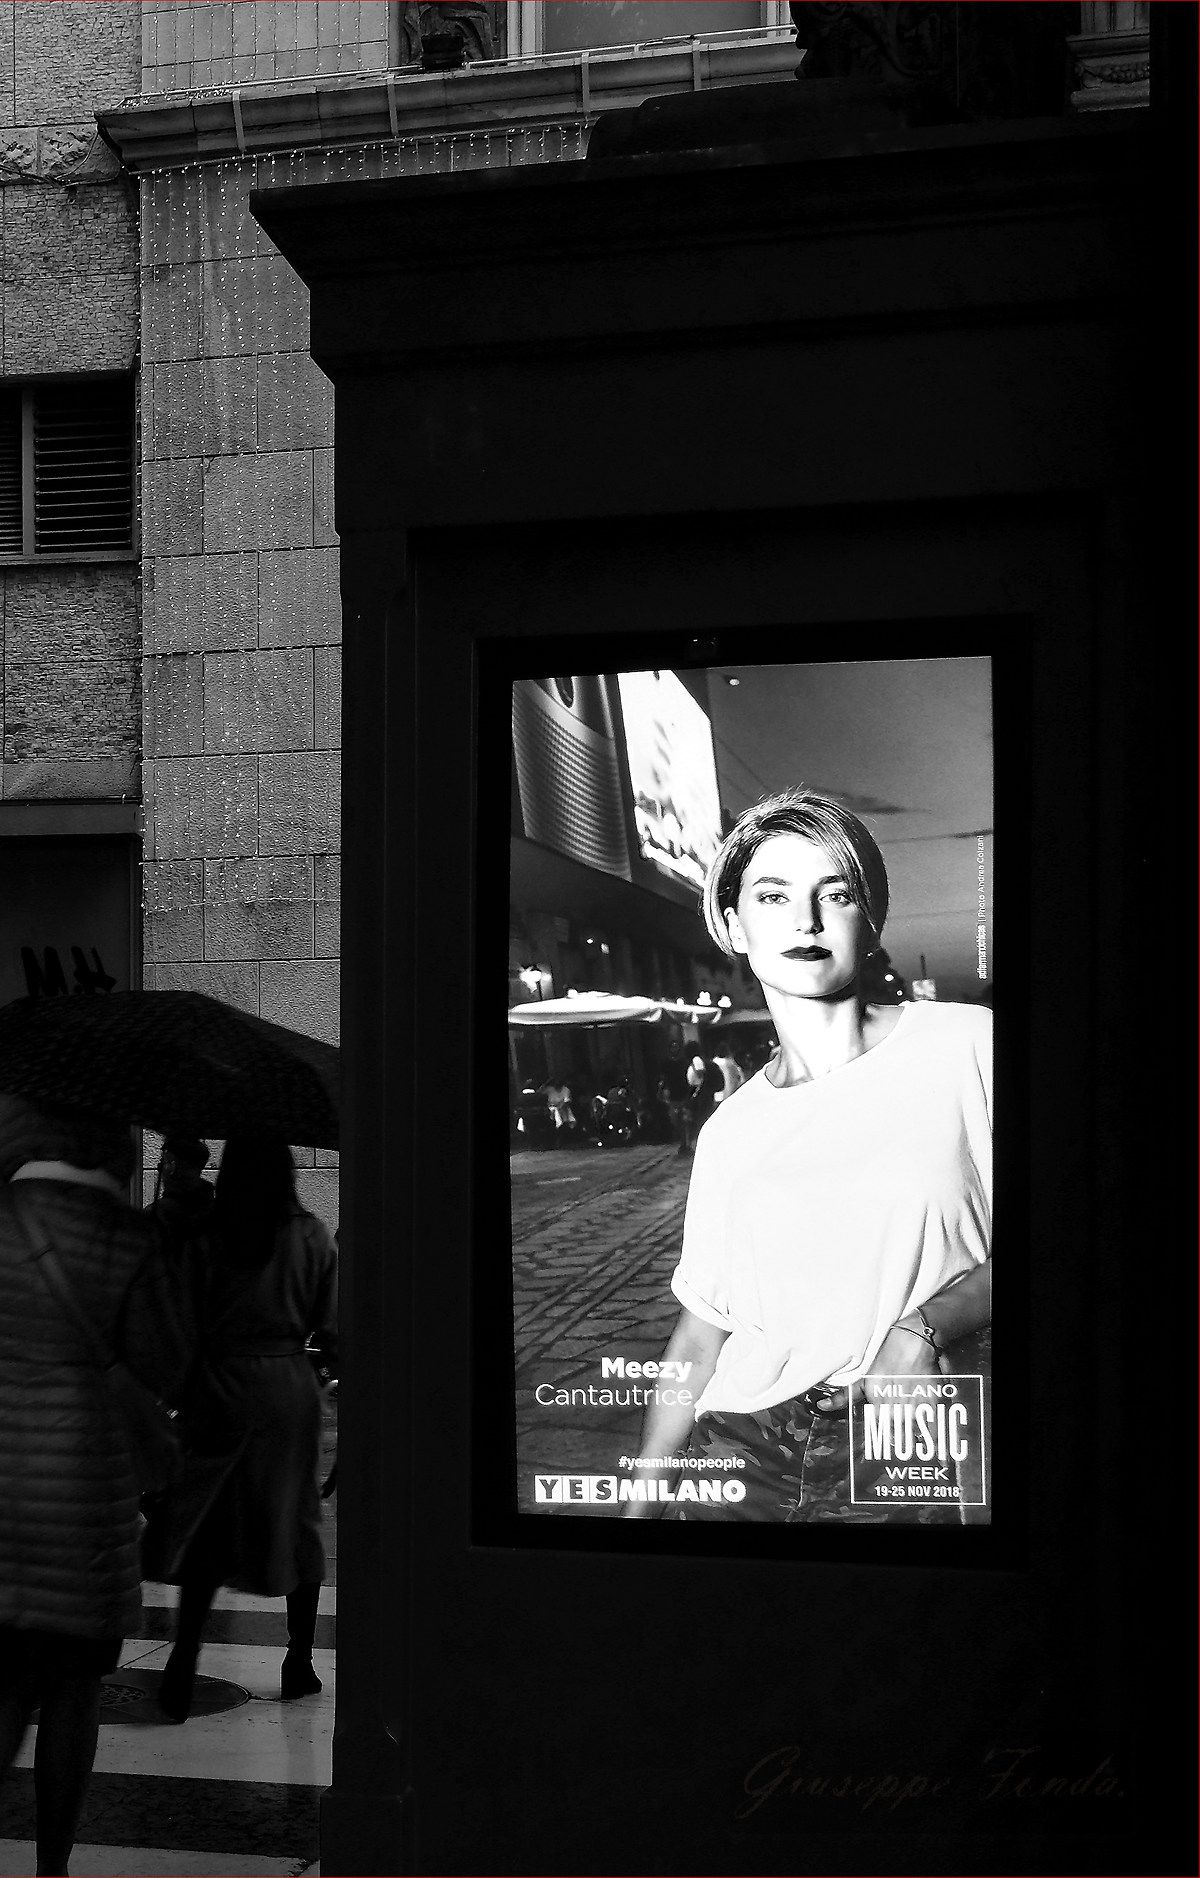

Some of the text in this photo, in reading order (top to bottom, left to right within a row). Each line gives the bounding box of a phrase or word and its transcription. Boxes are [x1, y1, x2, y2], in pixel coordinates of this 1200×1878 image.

[601, 1356, 693, 1382] Meezy
[535, 1383, 693, 1406] Cantautrice
[873, 1384, 958, 1398] MILANO
[863, 1403, 969, 1462] MUSIC
[618, 1455, 746, 1472] #yesmilanopeople
[884, 1466, 950, 1481] WEEK
[874, 1485, 960, 1498] 19-25 NOV 2018
